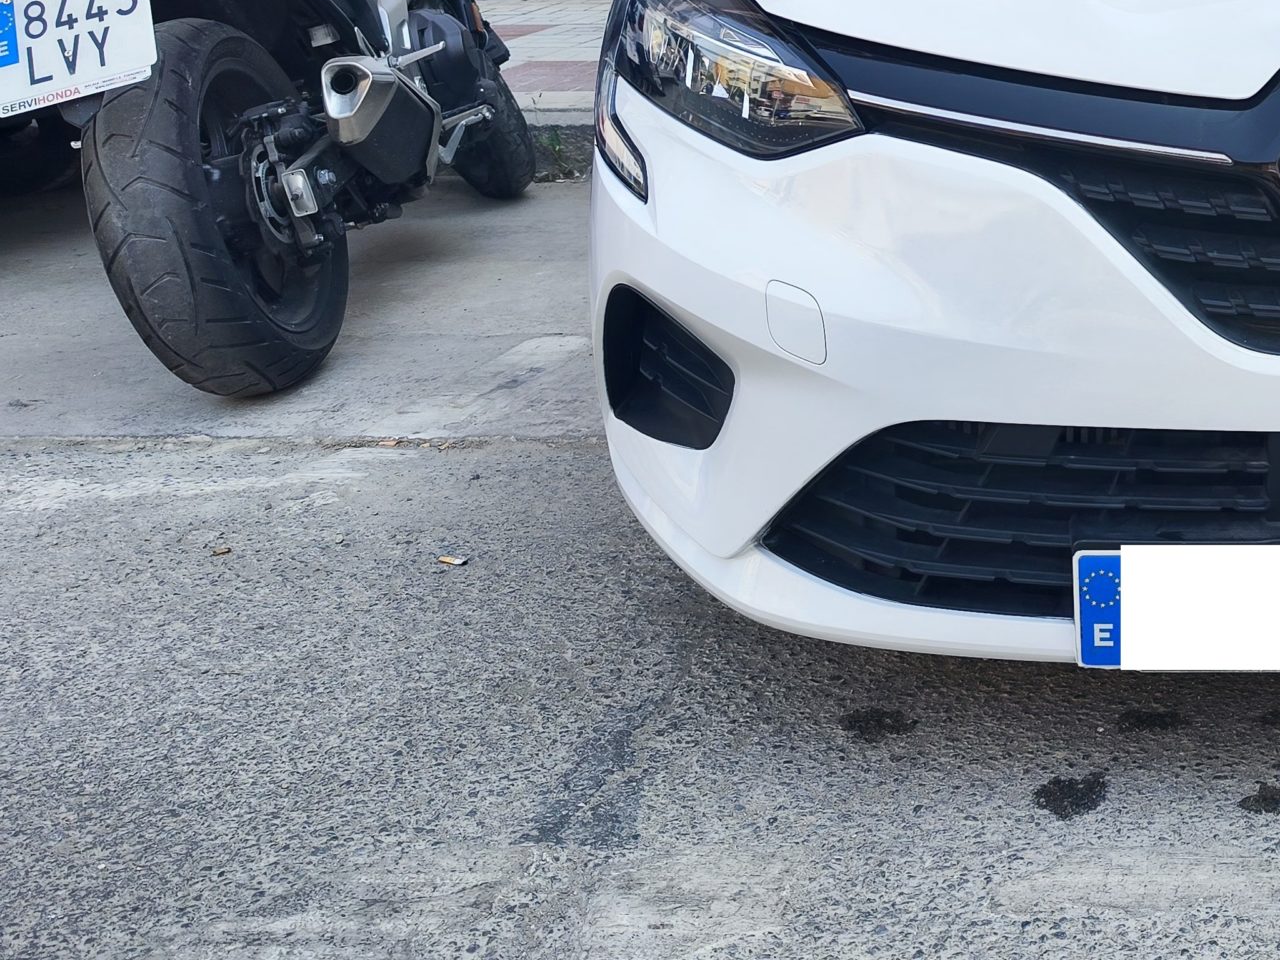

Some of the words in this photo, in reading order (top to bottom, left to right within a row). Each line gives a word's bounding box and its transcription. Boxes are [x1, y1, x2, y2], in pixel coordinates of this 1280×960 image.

[26, 26, 110, 86] LVY
[1, 87, 81, 115] SERVIHONDA
[1093, 623, 1115, 647] E
